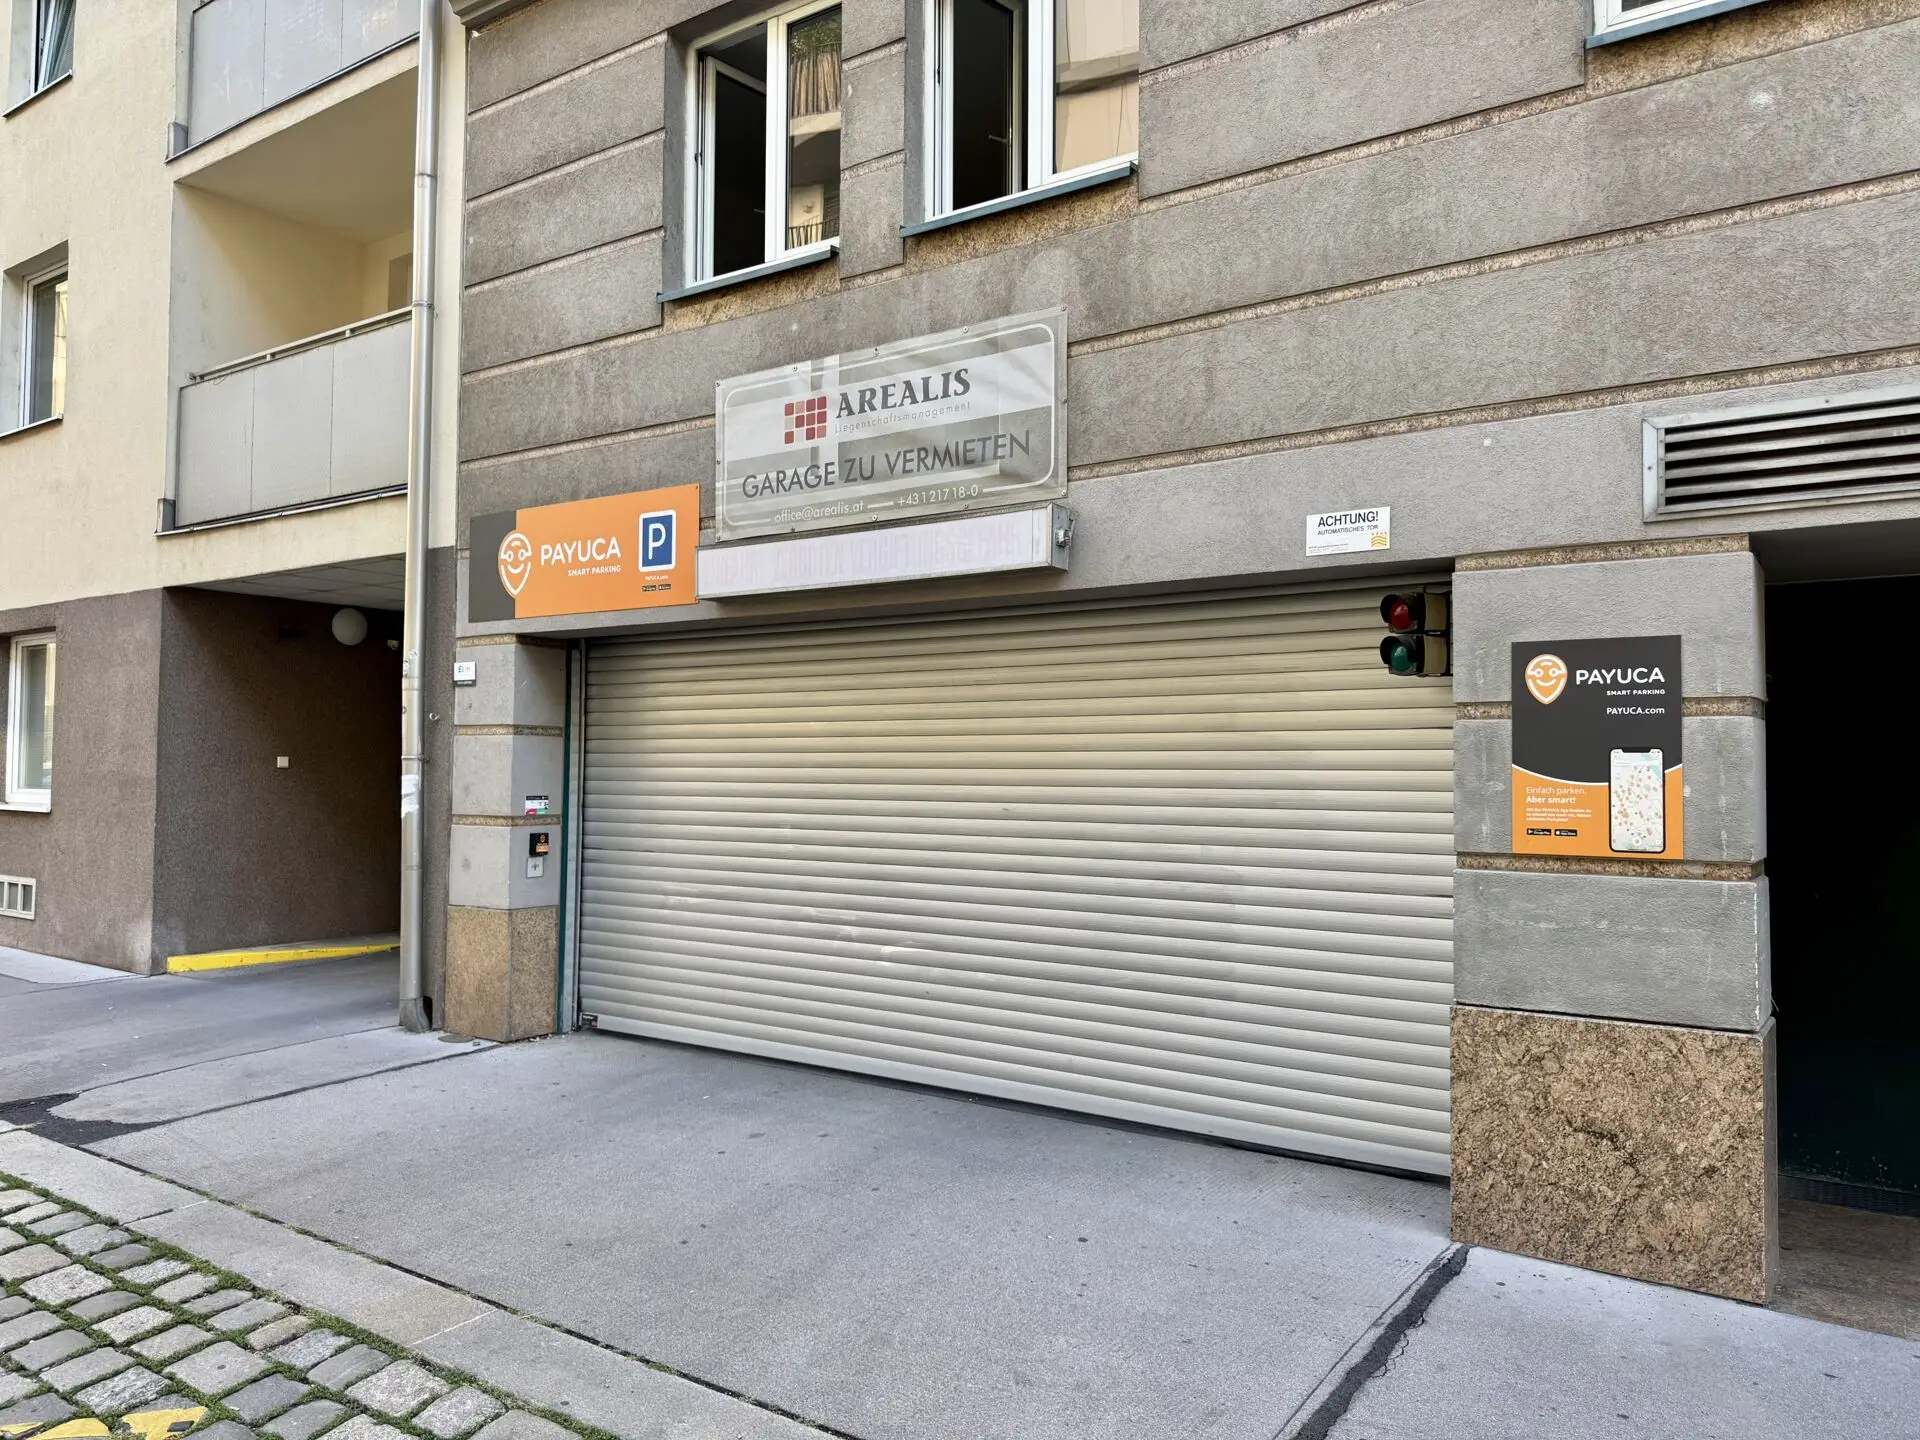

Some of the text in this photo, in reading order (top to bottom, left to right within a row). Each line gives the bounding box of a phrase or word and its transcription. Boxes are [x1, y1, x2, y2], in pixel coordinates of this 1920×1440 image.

[835, 368, 971, 419] AREALIS
[742, 429, 1031, 498] GARAGE ZU VERMIETEN
[774, 500, 864, 523] office@arealis.at
[1317, 510, 1379, 527] ACHTUNG!
[1317, 526, 1365, 536] AUTOMATISCHES
[648, 522, 666, 560] P
[540, 535, 622, 567] PAYUCA
[567, 564, 622, 577] SMART PARKING
[1575, 666, 1666, 685] PAYUCA
[1606, 706, 1665, 715] PAYUCA.com
[1526, 795, 1545, 804] Aber
